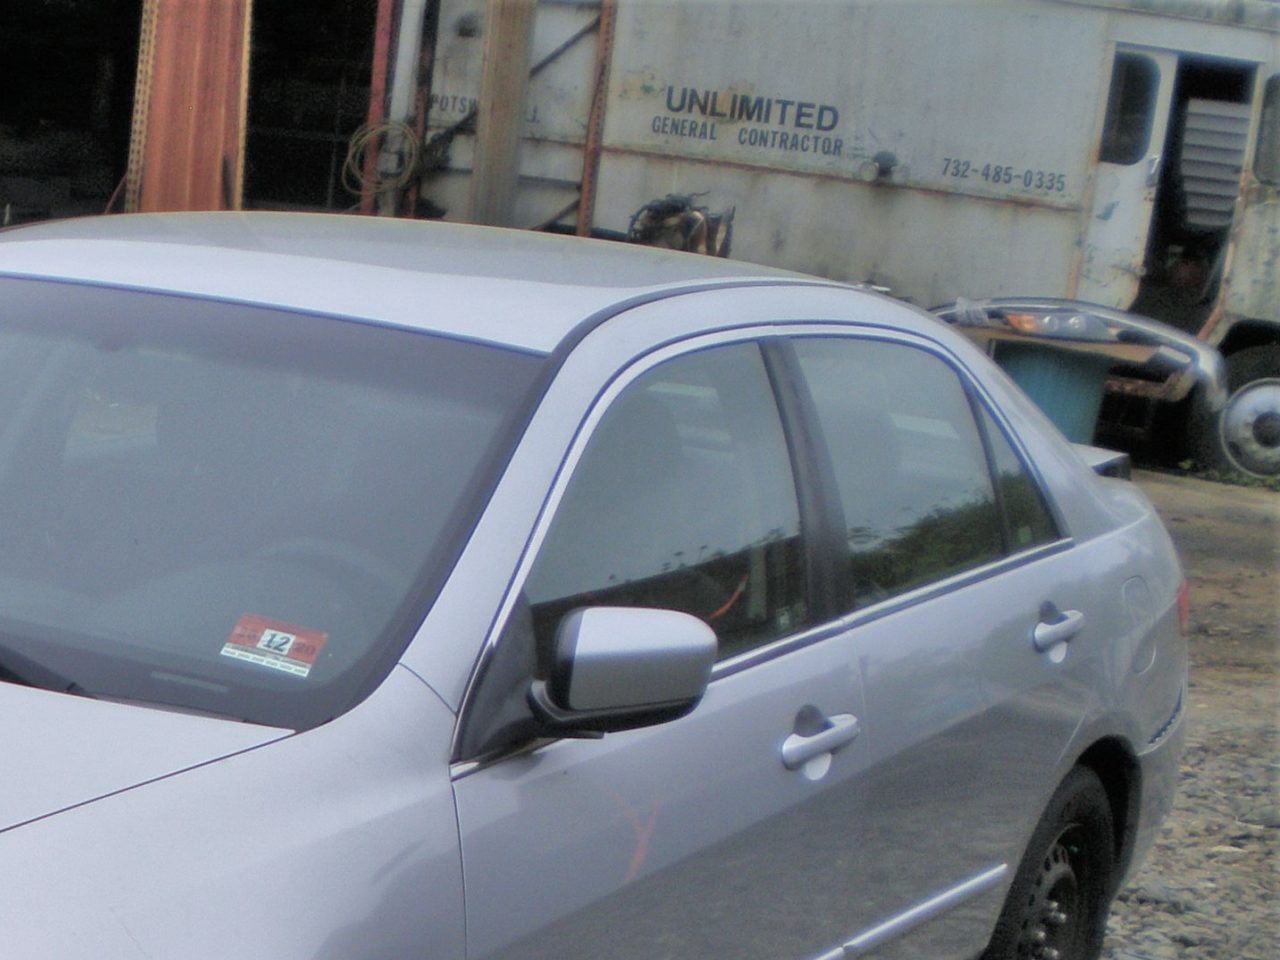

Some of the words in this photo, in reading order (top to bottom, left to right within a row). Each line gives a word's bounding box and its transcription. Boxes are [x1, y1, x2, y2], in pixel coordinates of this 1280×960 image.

[666, 85, 839, 132] UNLIMITED
[652, 115, 718, 140] GENERAL
[738, 127, 844, 157] CONTRACTOR
[942, 158, 1066, 193] 732-485-0335
[263, 632, 290, 652] 12
